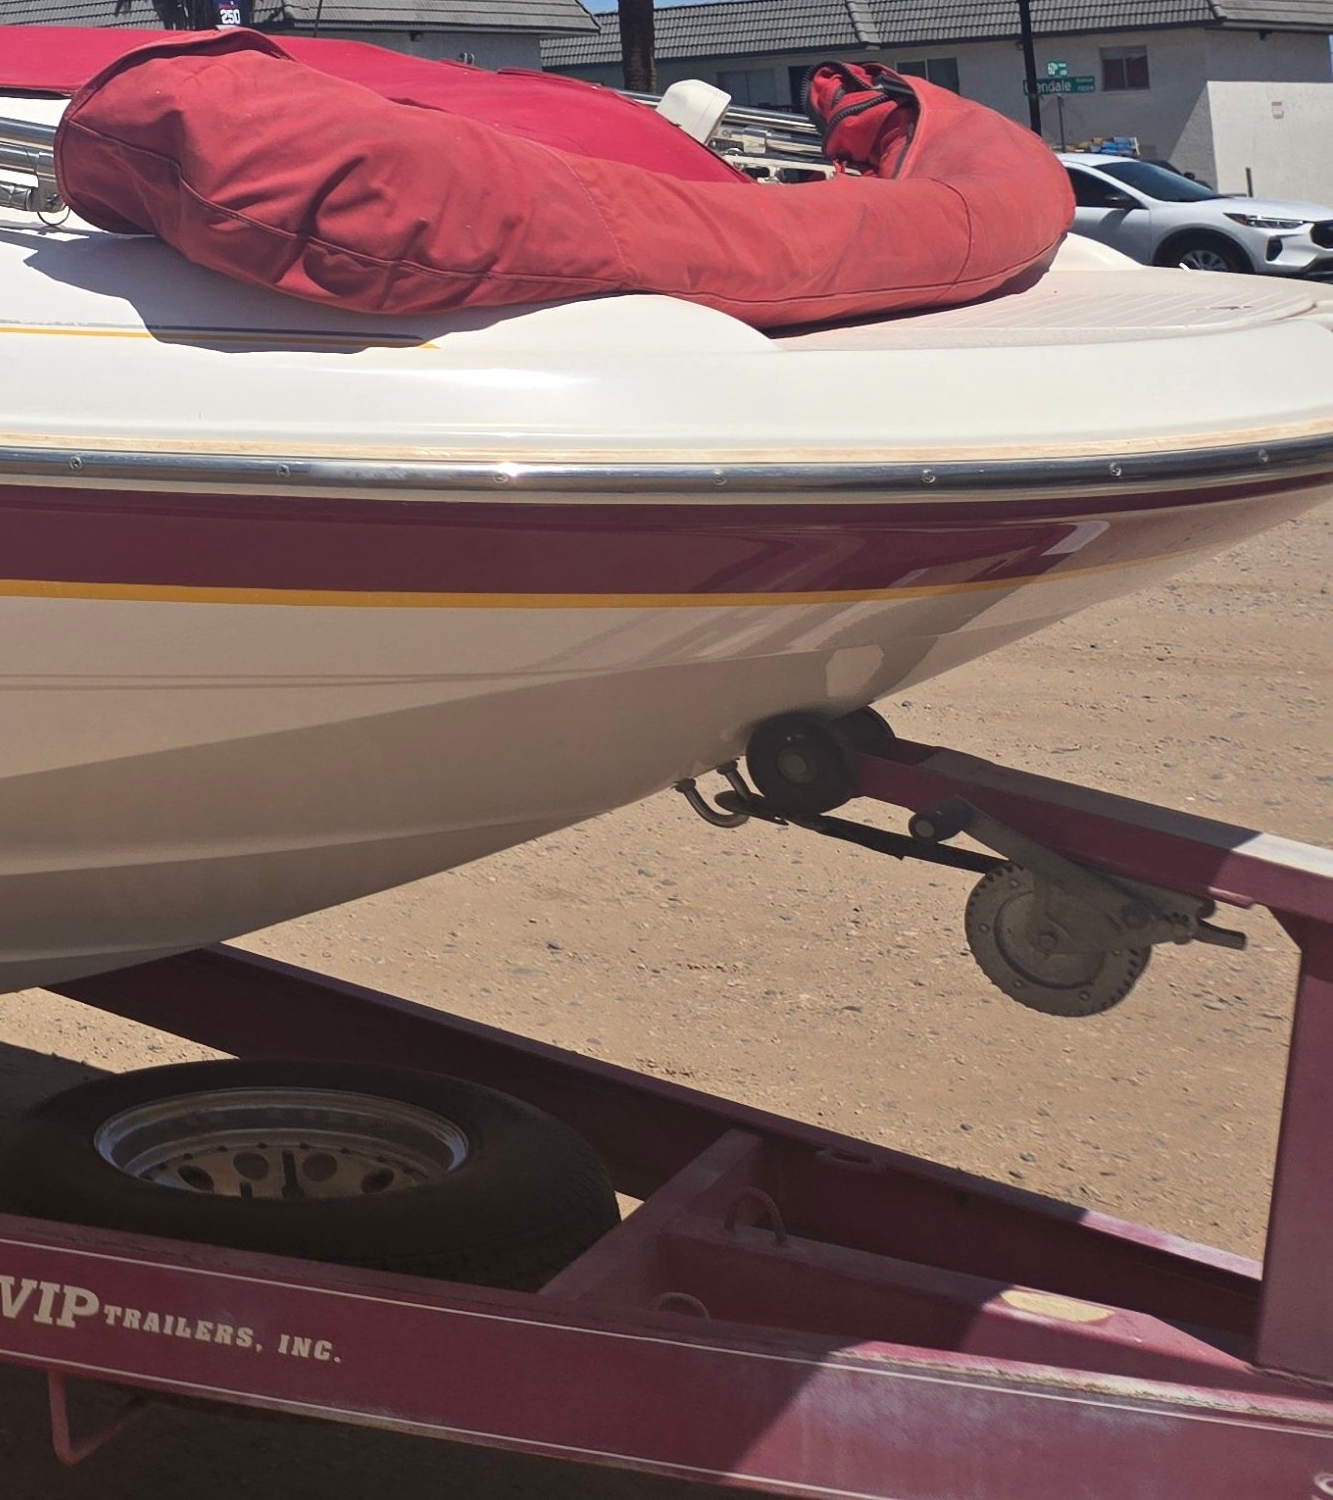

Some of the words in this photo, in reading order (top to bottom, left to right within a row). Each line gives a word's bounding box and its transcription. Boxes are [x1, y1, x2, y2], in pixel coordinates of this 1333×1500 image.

[219, 8, 241, 24] 250
[1024, 80, 1072, 93] endale
[103, 1304, 262, 1352] TRAILERS,
[277, 1334, 341, 1363] INC.
